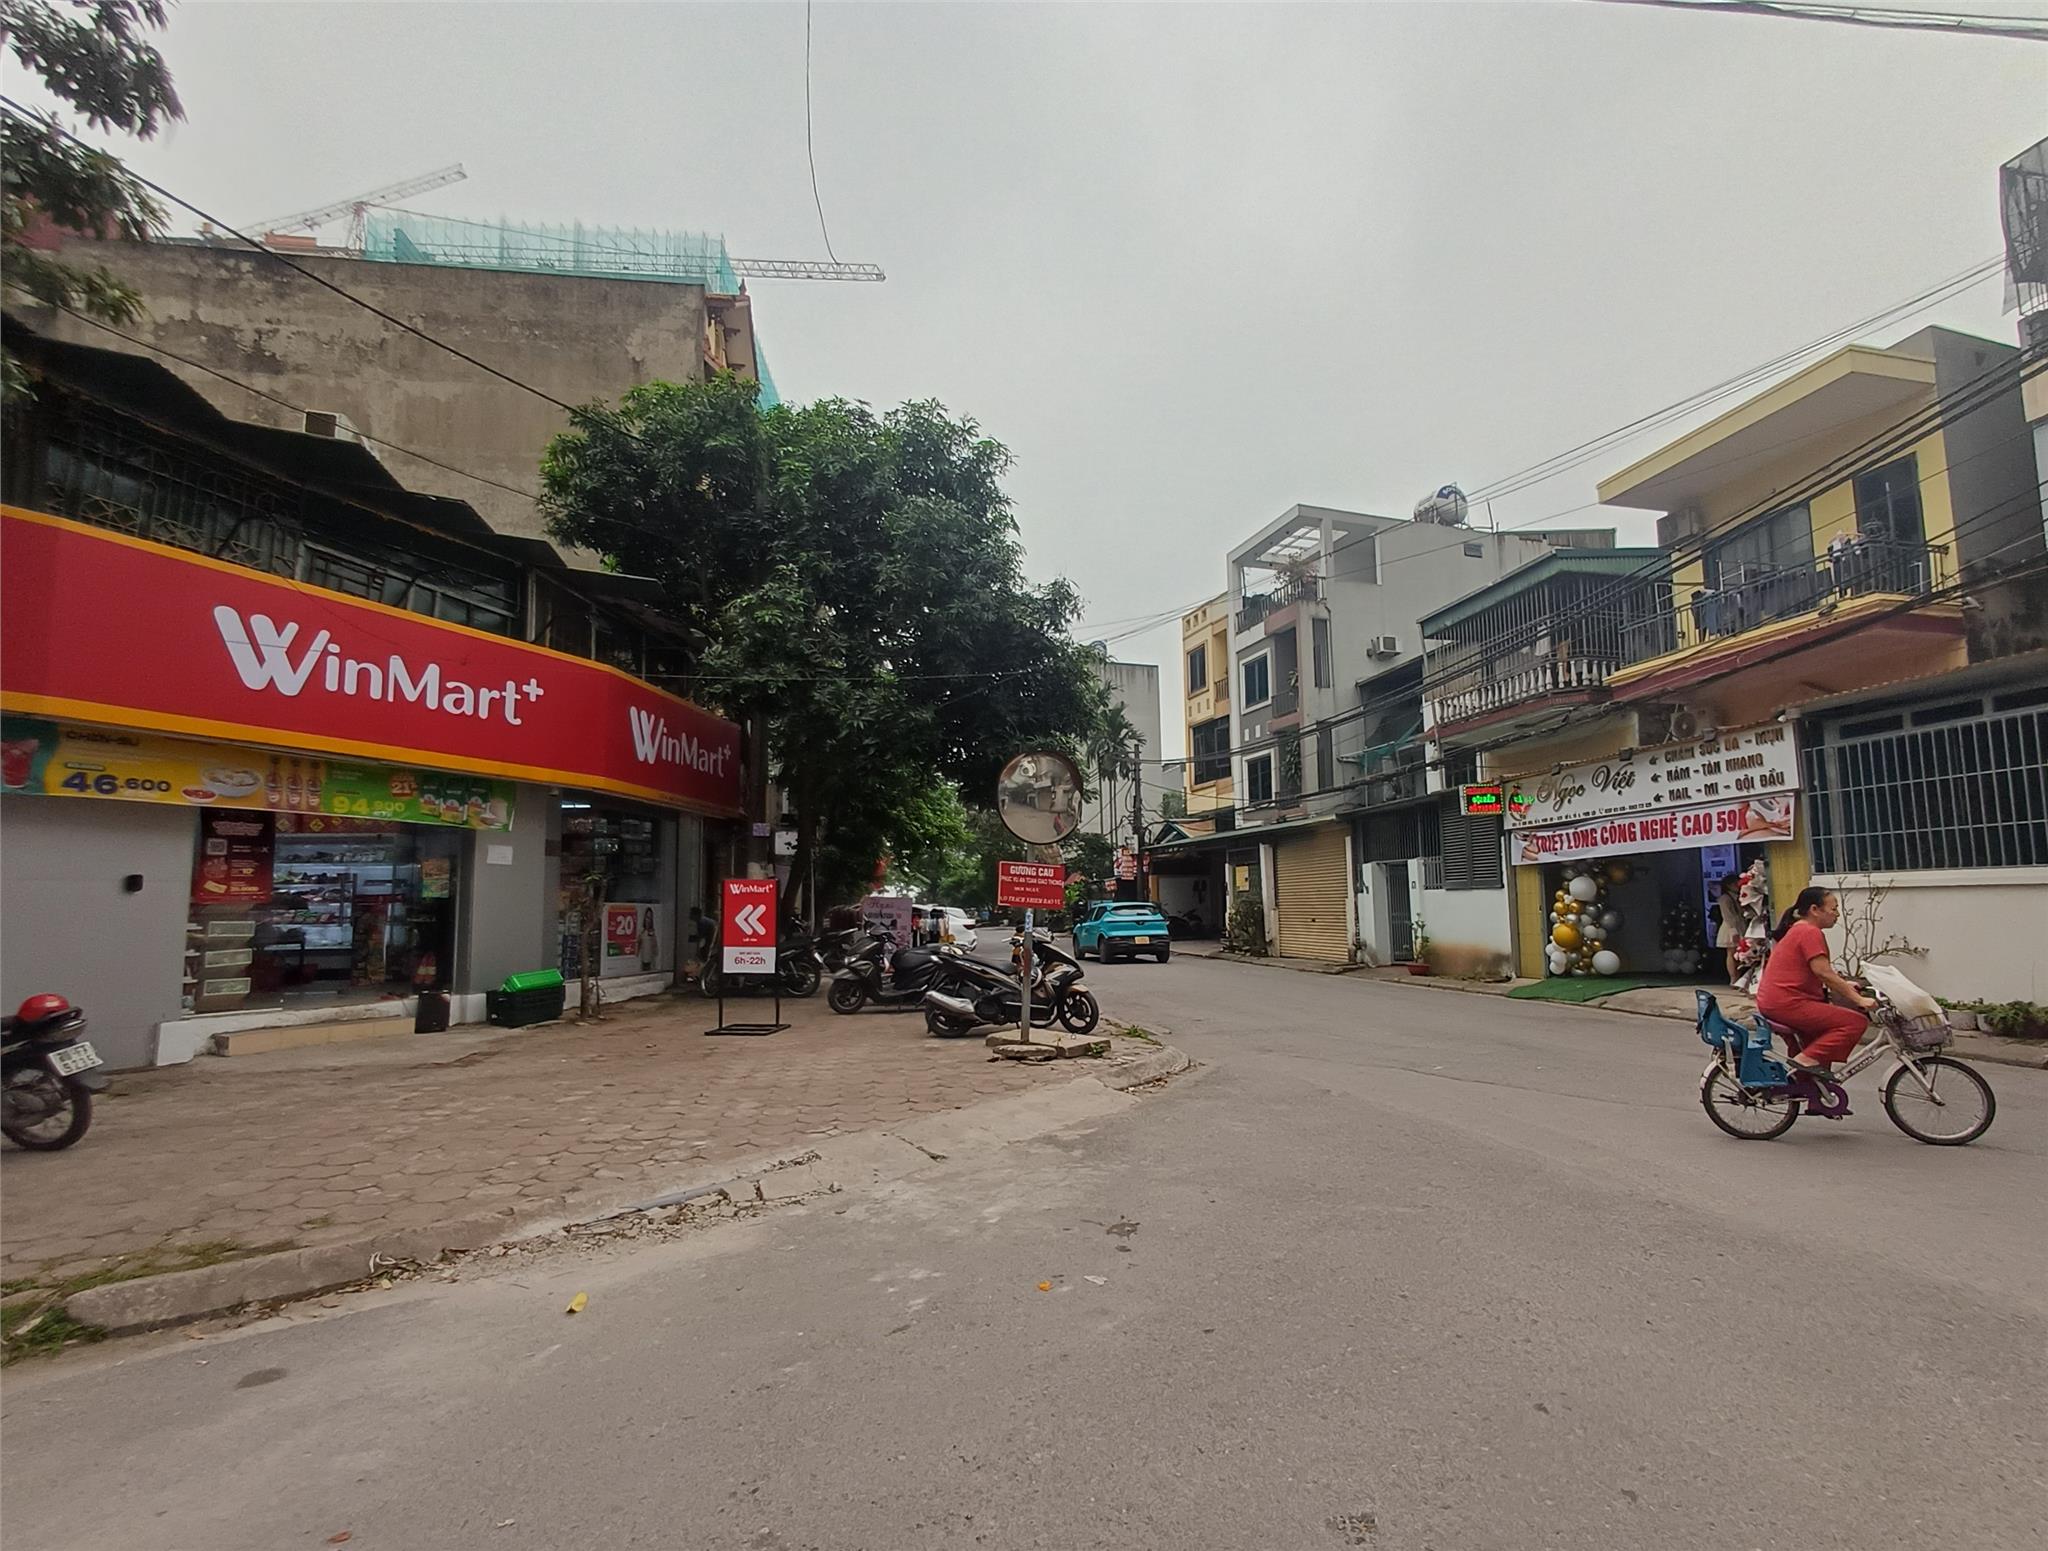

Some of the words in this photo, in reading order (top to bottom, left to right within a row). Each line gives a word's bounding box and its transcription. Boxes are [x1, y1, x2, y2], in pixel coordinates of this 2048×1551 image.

[213, 605, 545, 726] WinMart+
[630, 705, 732, 778] WinMart+
[1600, 821, 1637, 845] CÔNG
[1640, 811, 1678, 842] NGHỆ
[1681, 812, 1713, 837] CAO
[1716, 807, 1749, 833] 59K
